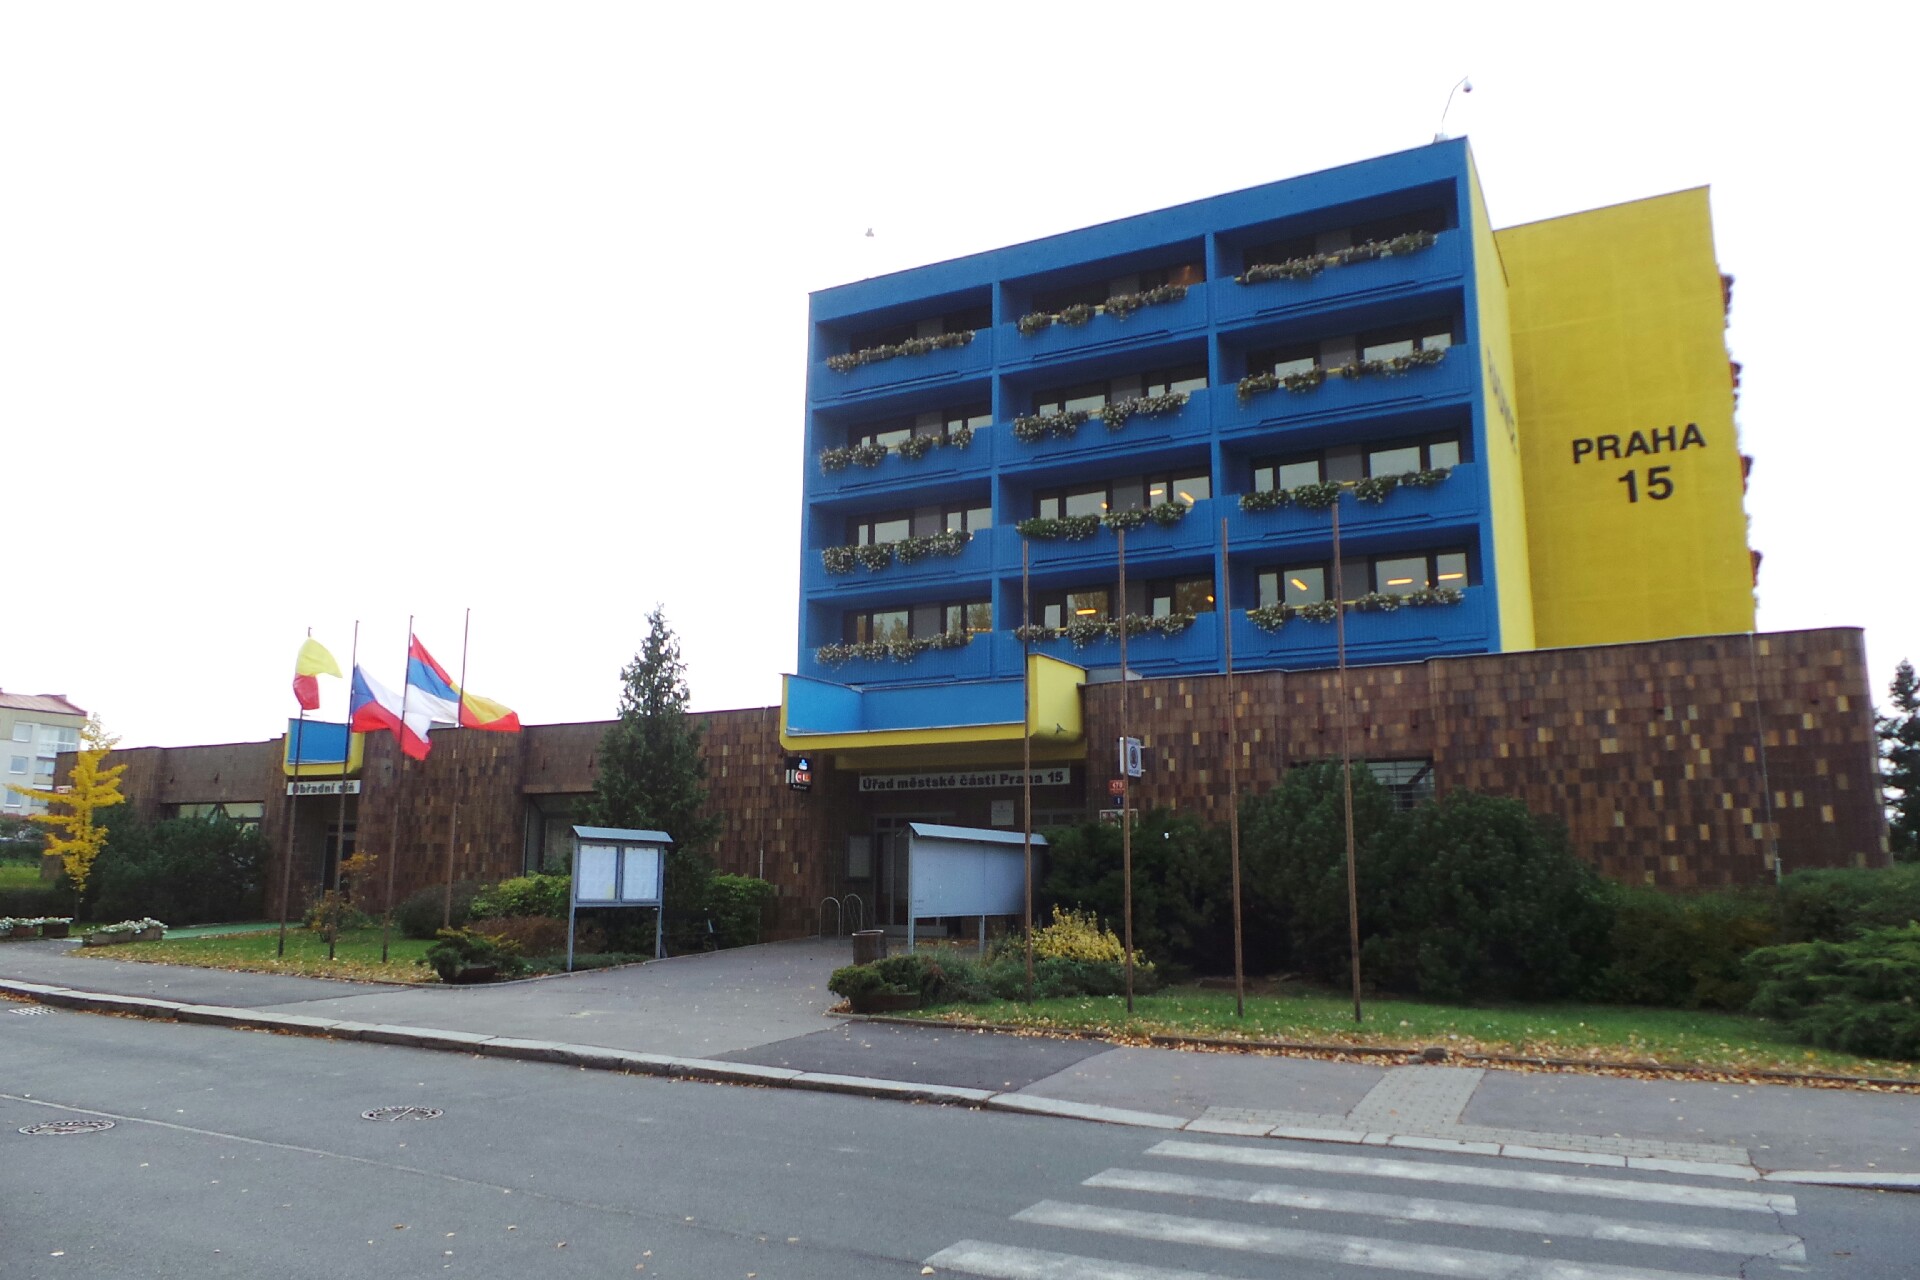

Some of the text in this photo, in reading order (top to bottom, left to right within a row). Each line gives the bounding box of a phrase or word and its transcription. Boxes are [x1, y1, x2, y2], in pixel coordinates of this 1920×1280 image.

[1572, 422, 1707, 464] PRAHA
[1618, 465, 1674, 503] 15
[862, 777, 894, 790] Úřad
[897, 775, 956, 789] městské
[959, 774, 996, 786] části
[1047, 771, 1064, 783] 15
